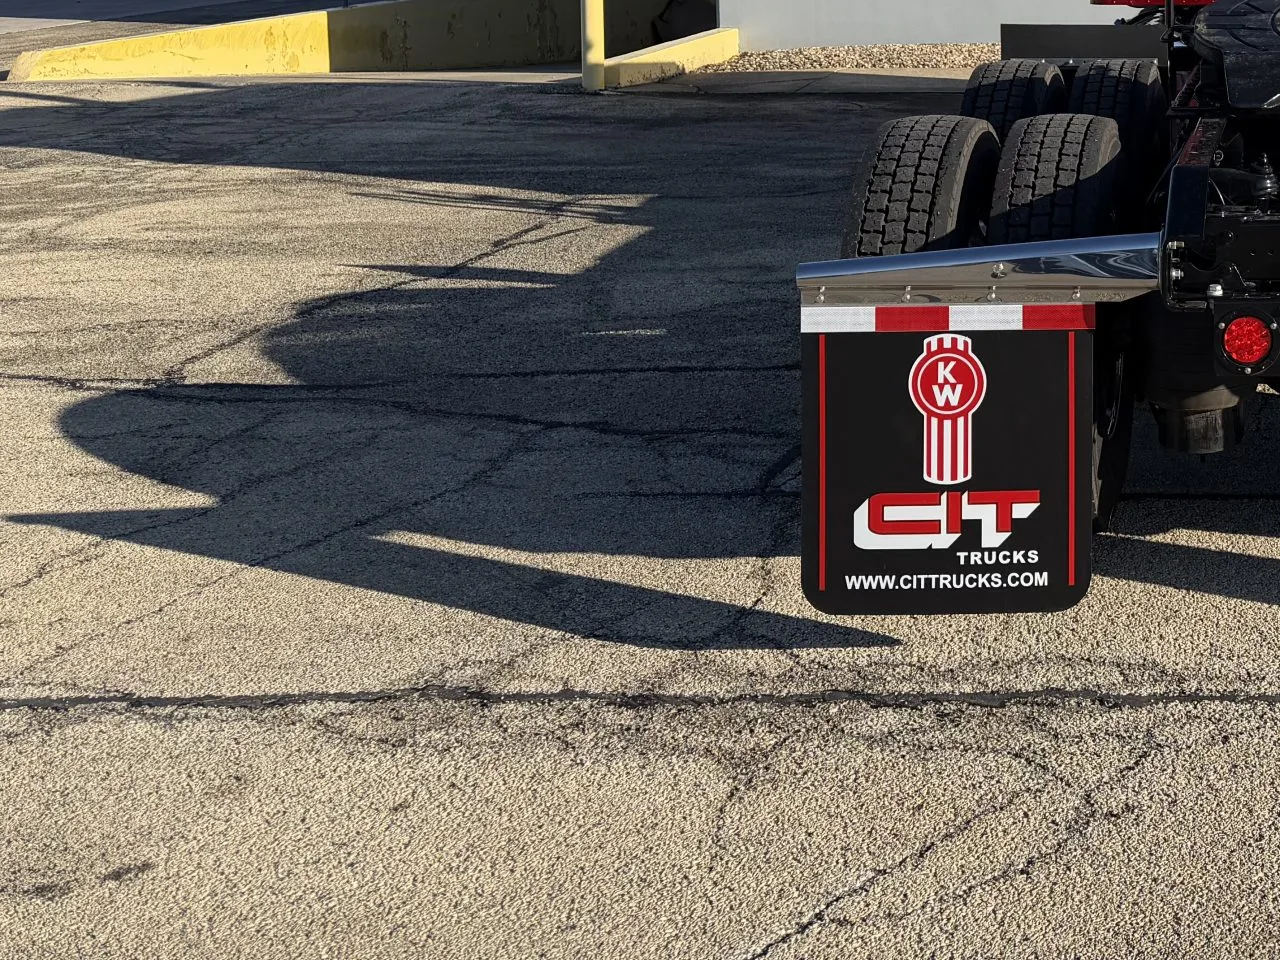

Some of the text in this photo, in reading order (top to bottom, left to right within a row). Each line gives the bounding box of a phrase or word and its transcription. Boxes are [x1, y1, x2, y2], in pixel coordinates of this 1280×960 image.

[937, 360, 957, 384] K
[932, 383, 963, 407] W
[853, 490, 1041, 550] CIT
[956, 550, 1040, 565] TRUCKS
[845, 572, 1049, 590] WWW.CITTRUCKS.COM
